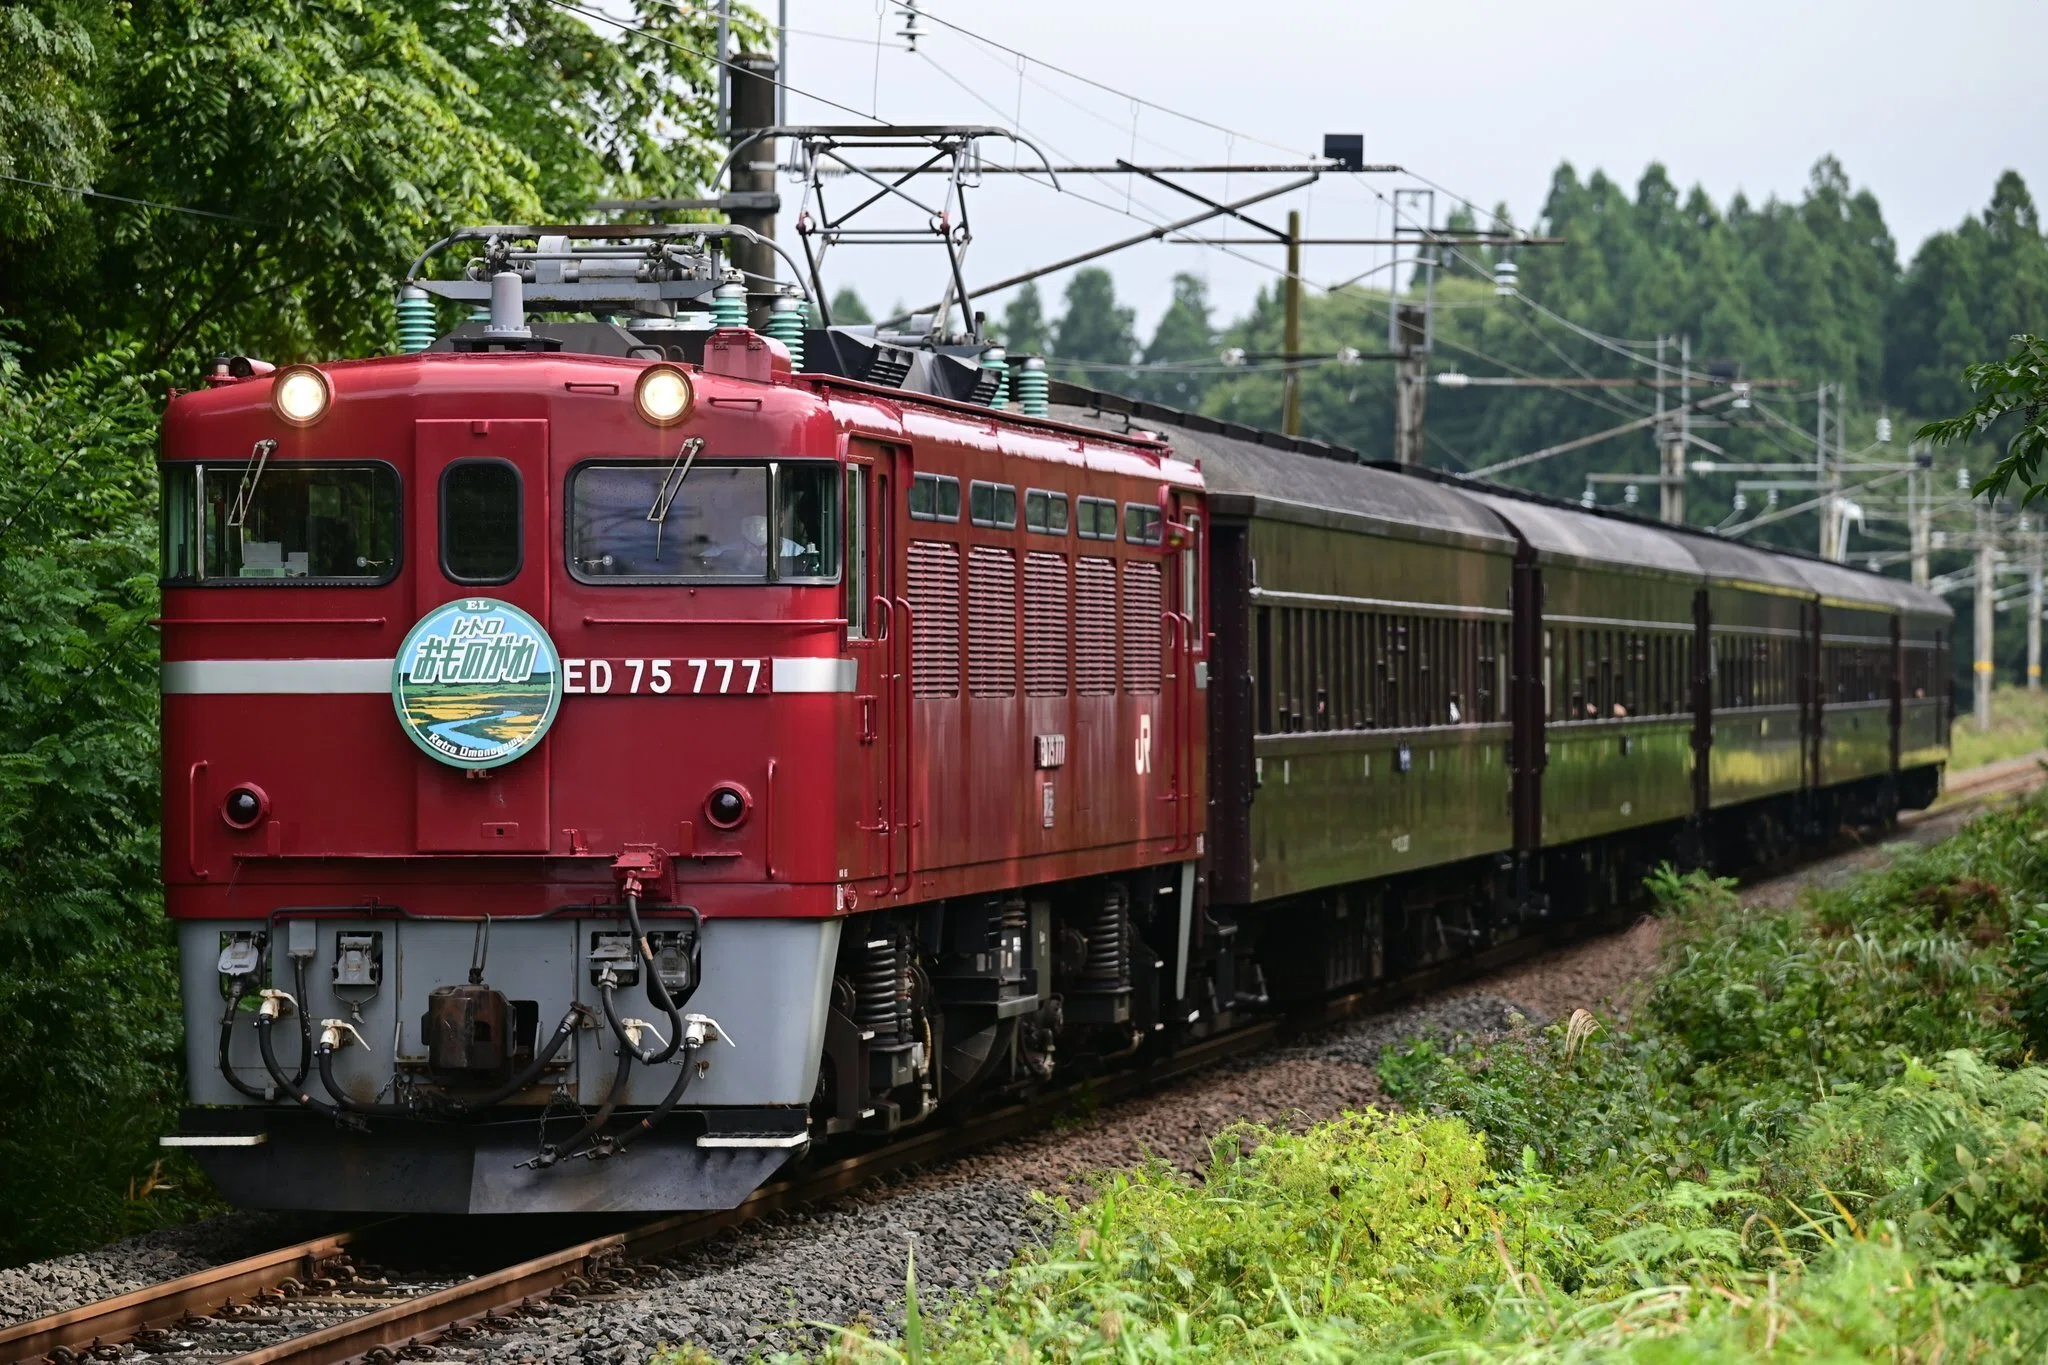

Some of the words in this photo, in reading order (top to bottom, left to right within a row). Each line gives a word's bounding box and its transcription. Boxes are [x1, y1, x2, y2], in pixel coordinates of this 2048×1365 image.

[466, 600, 490, 611] EL
[452, 618, 504, 636] レトロ
[412, 636, 537, 681] おものがわ
[563, 659, 613, 694] ED
[624, 659, 673, 694] 75
[687, 659, 762, 694] 777
[1134, 714, 1152, 776] JR
